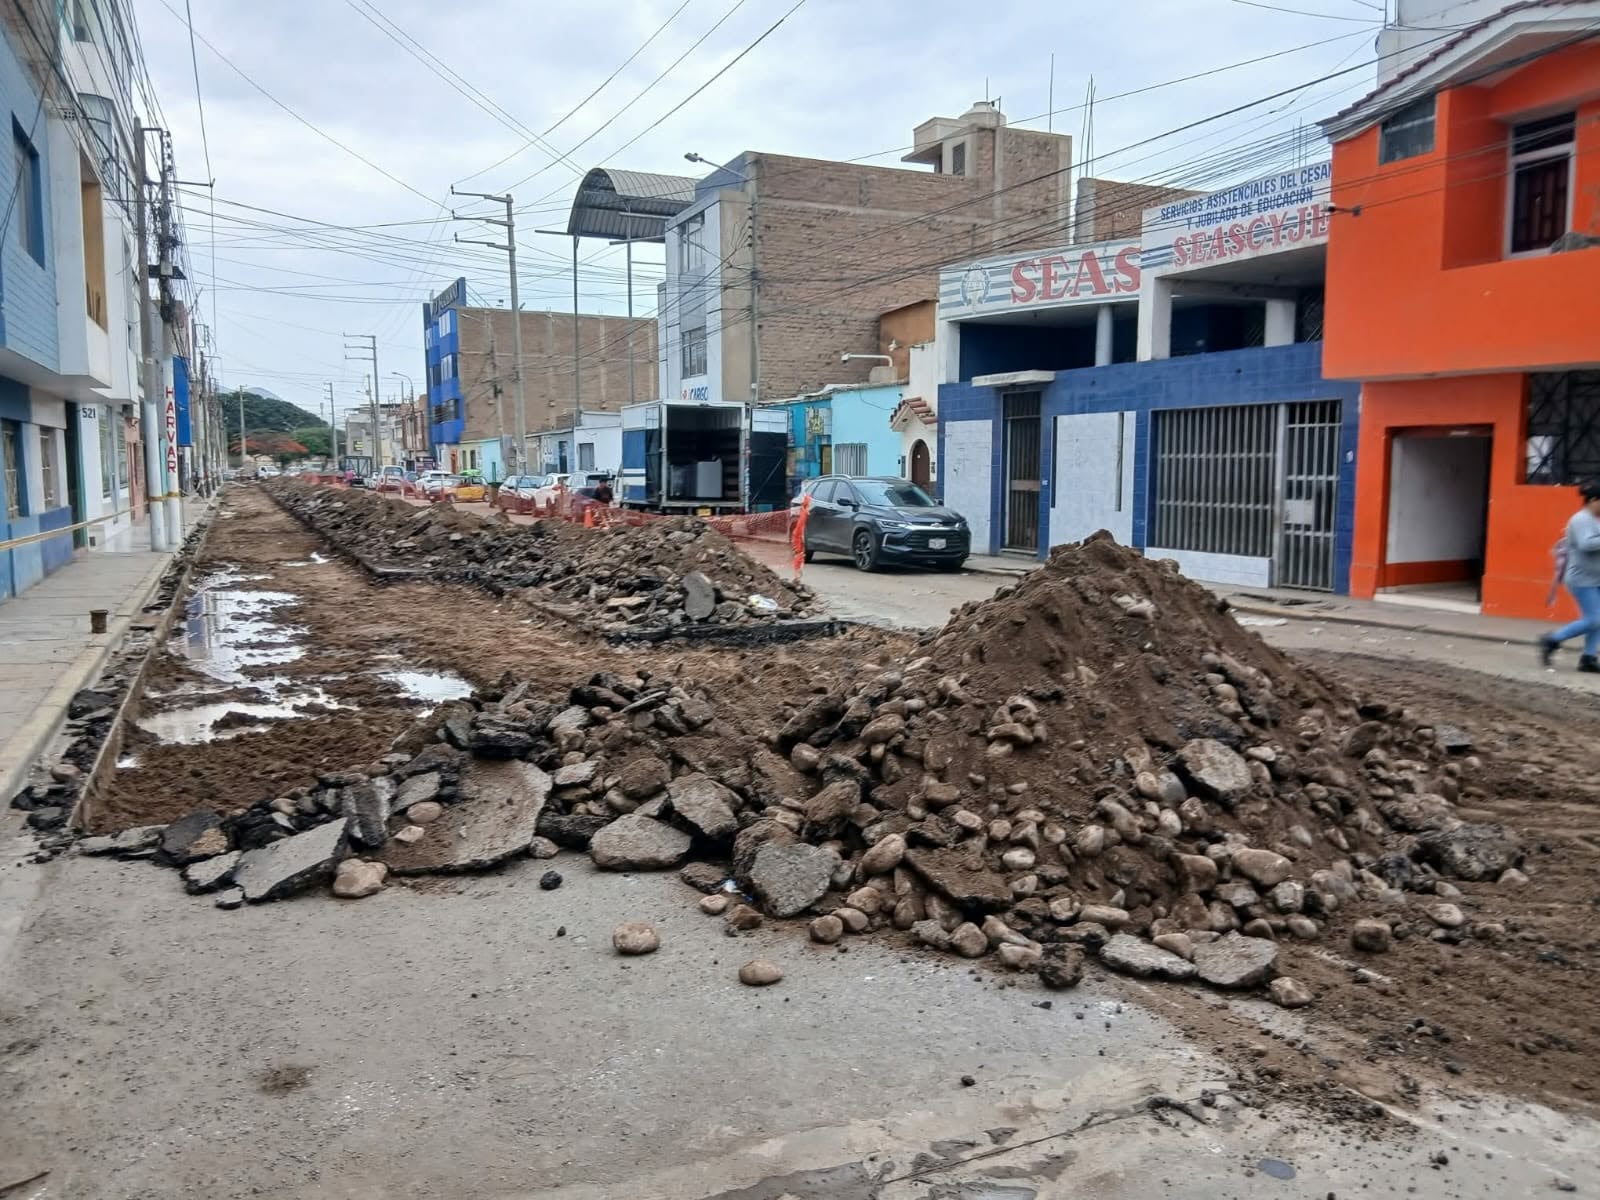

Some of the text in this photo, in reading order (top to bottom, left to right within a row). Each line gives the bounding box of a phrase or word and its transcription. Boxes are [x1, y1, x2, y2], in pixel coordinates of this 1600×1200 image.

[1161, 199, 1202, 221] SERVICIOS
[1206, 179, 1276, 210] ASISTENCIALES
[1280, 173, 1297, 190] DEL
[1241, 202, 1253, 218] DE
[1011, 246, 1142, 304] SEAS
[82, 407, 96, 419] 521
[165, 387, 177, 473] HARVAR
